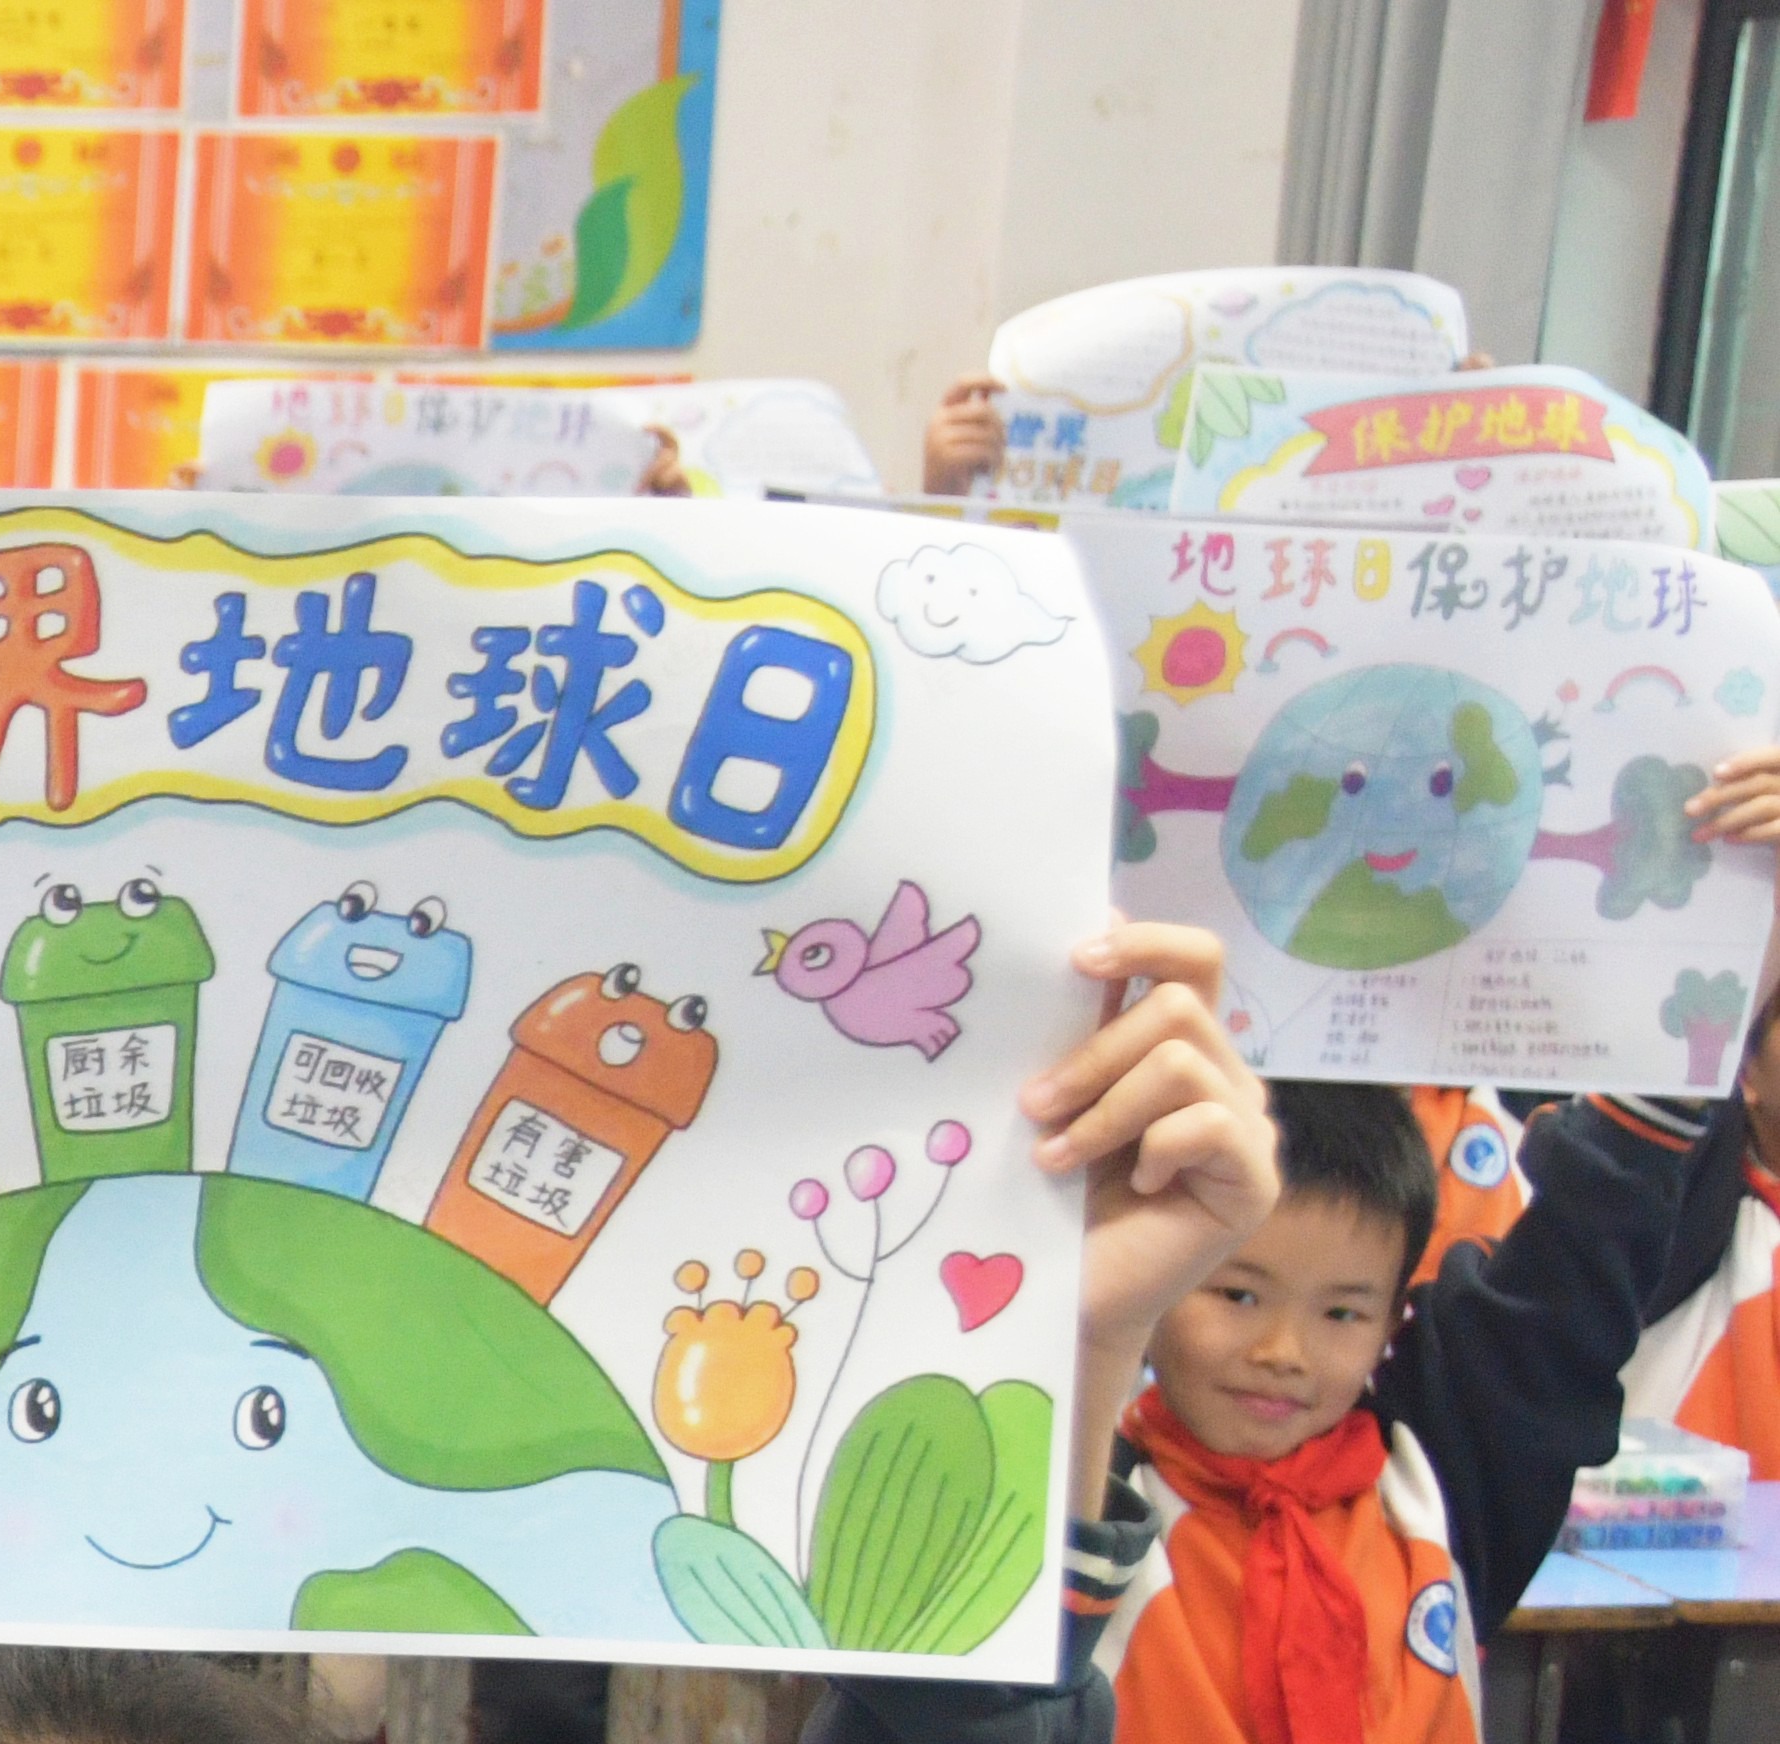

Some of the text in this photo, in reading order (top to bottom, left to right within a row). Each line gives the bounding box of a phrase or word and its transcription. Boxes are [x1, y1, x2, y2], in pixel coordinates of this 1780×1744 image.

[1352, 394, 1590, 466] 保护地球
[1169, 530, 1708, 636] 地球日保护地球
[60, 1032, 150, 1081] 厨余
[293, 1042, 388, 1103] 可回收
[63, 1081, 161, 1119] 垃圾
[280, 1093, 362, 1142] 垃圾
[502, 1112, 592, 1180] 有害
[482, 1162, 572, 1218] 垃圾
